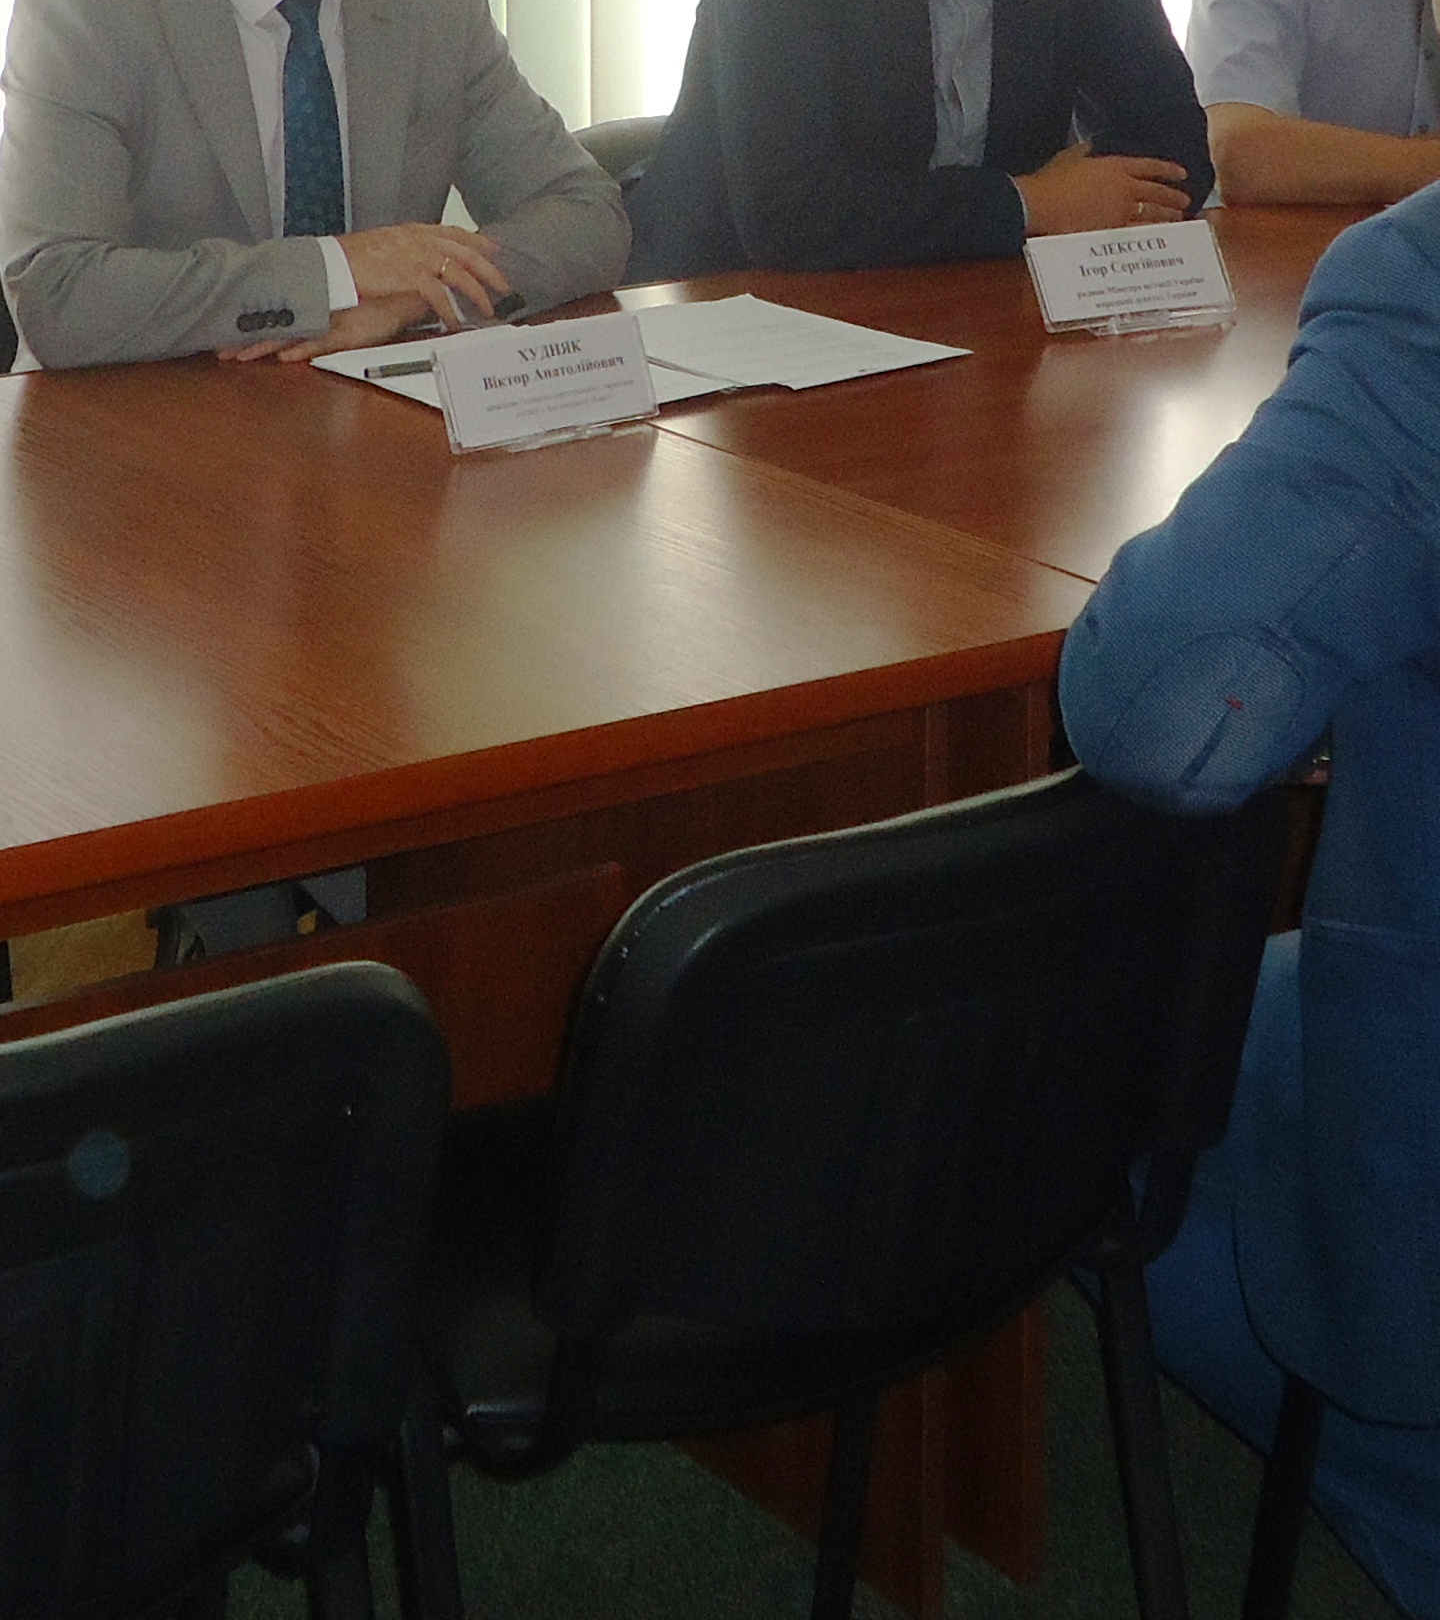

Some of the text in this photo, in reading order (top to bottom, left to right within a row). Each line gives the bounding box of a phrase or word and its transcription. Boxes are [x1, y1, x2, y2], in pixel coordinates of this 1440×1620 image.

[1079, 255, 1185, 278] Ігор Сергійович
[517, 339, 582, 362] ХУДНЯК
[483, 355, 625, 392] Віктор Анатолійович
